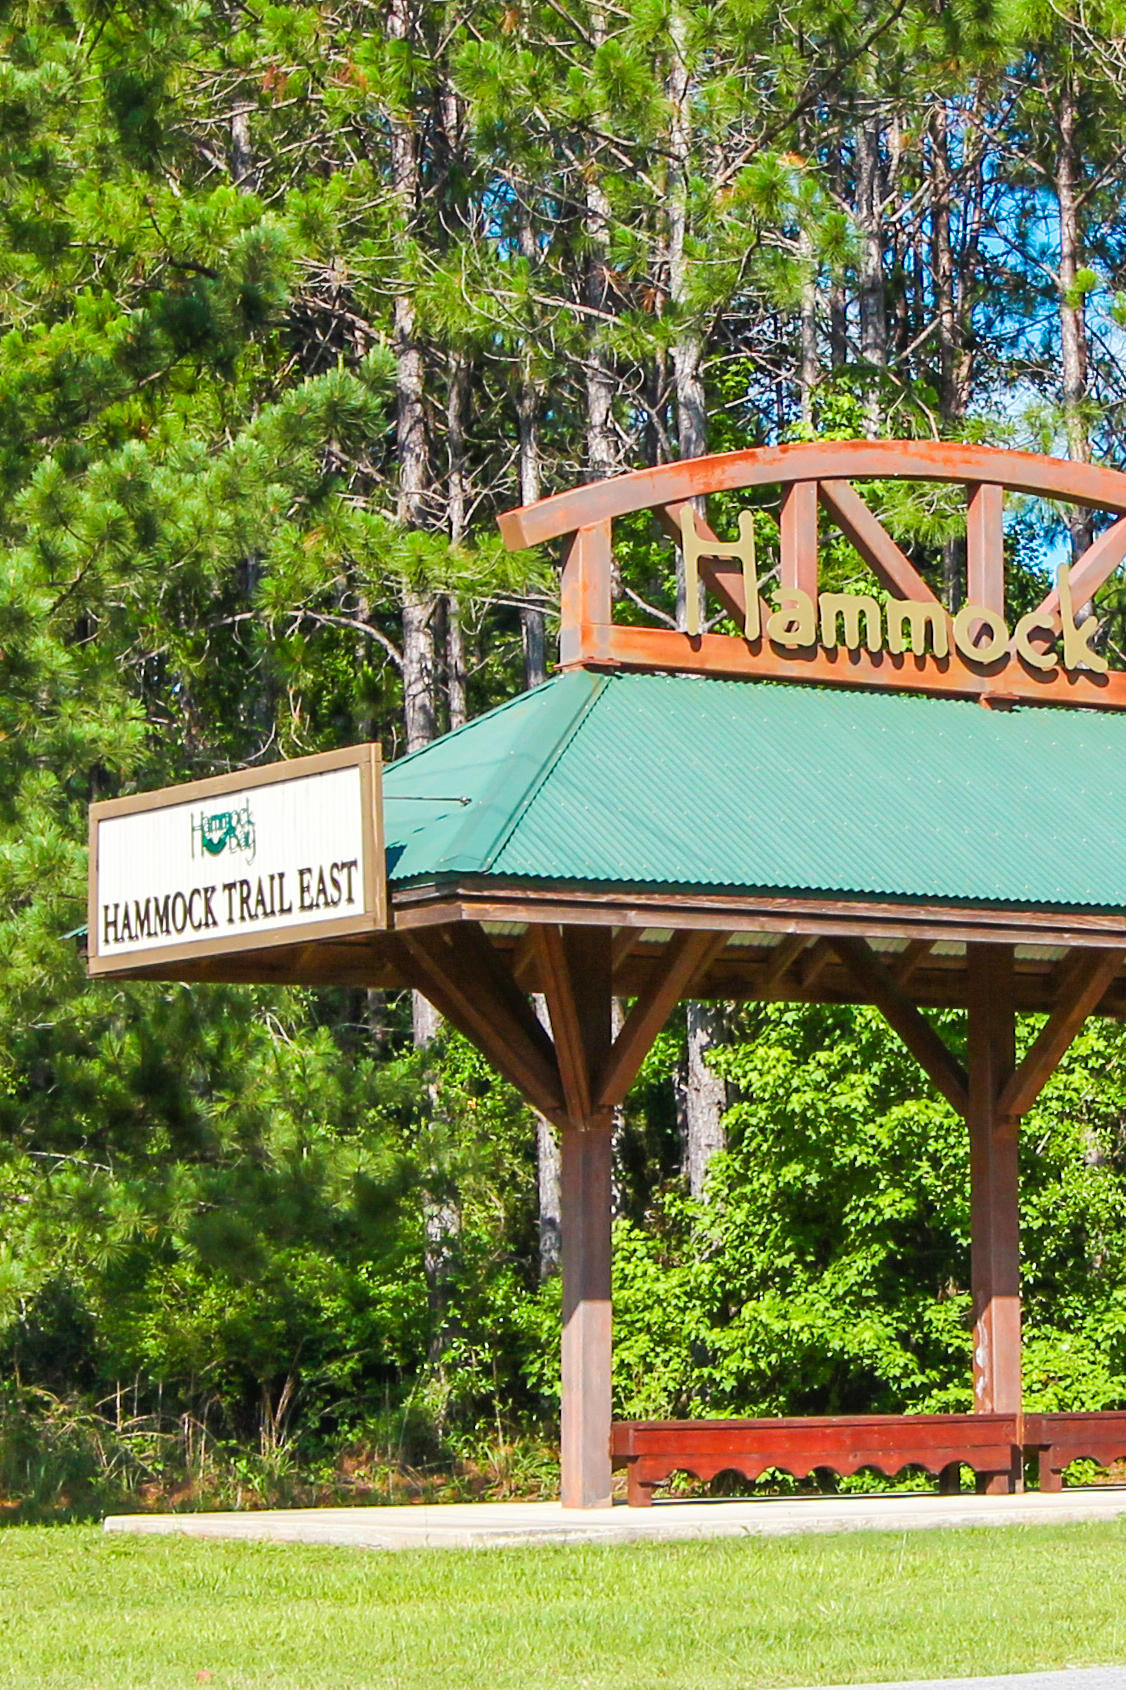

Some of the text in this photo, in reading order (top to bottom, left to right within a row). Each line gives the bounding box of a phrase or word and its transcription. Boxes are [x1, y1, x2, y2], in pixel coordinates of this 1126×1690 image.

[680, 502, 1108, 674] Hammock
[191, 797, 254, 859] Hammock
[103, 859, 358, 944] HAMMOCK TRAIL EAST
